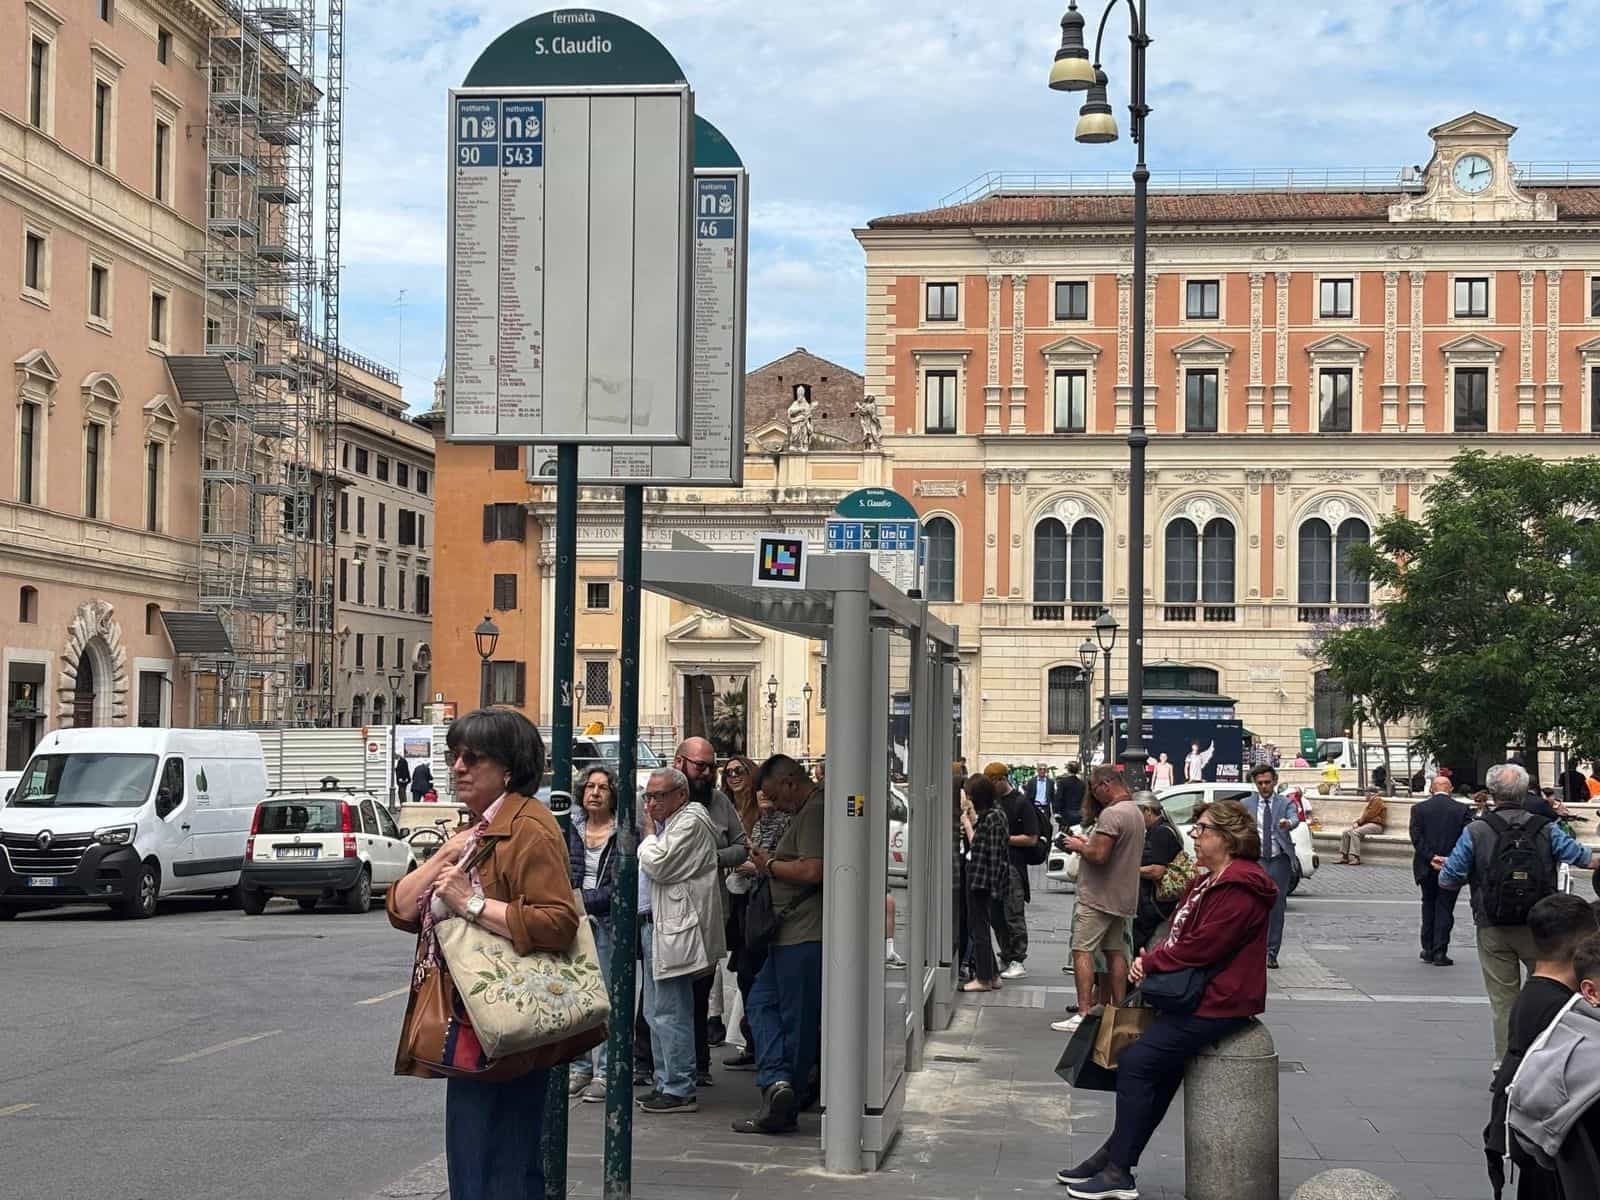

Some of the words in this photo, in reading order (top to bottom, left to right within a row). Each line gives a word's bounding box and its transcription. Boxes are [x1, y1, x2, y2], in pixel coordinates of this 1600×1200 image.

[552, 12, 595, 24] fermata
[535, 37, 549, 54] S.
[552, 35, 612, 54] Claudio
[461, 116, 478, 138] n
[505, 116, 522, 138] n
[461, 147, 480, 164] 90
[505, 147, 533, 164] 543
[700, 194, 716, 214] n
[700, 221, 718, 236] 46
[866, 498, 892, 508] Claudio
